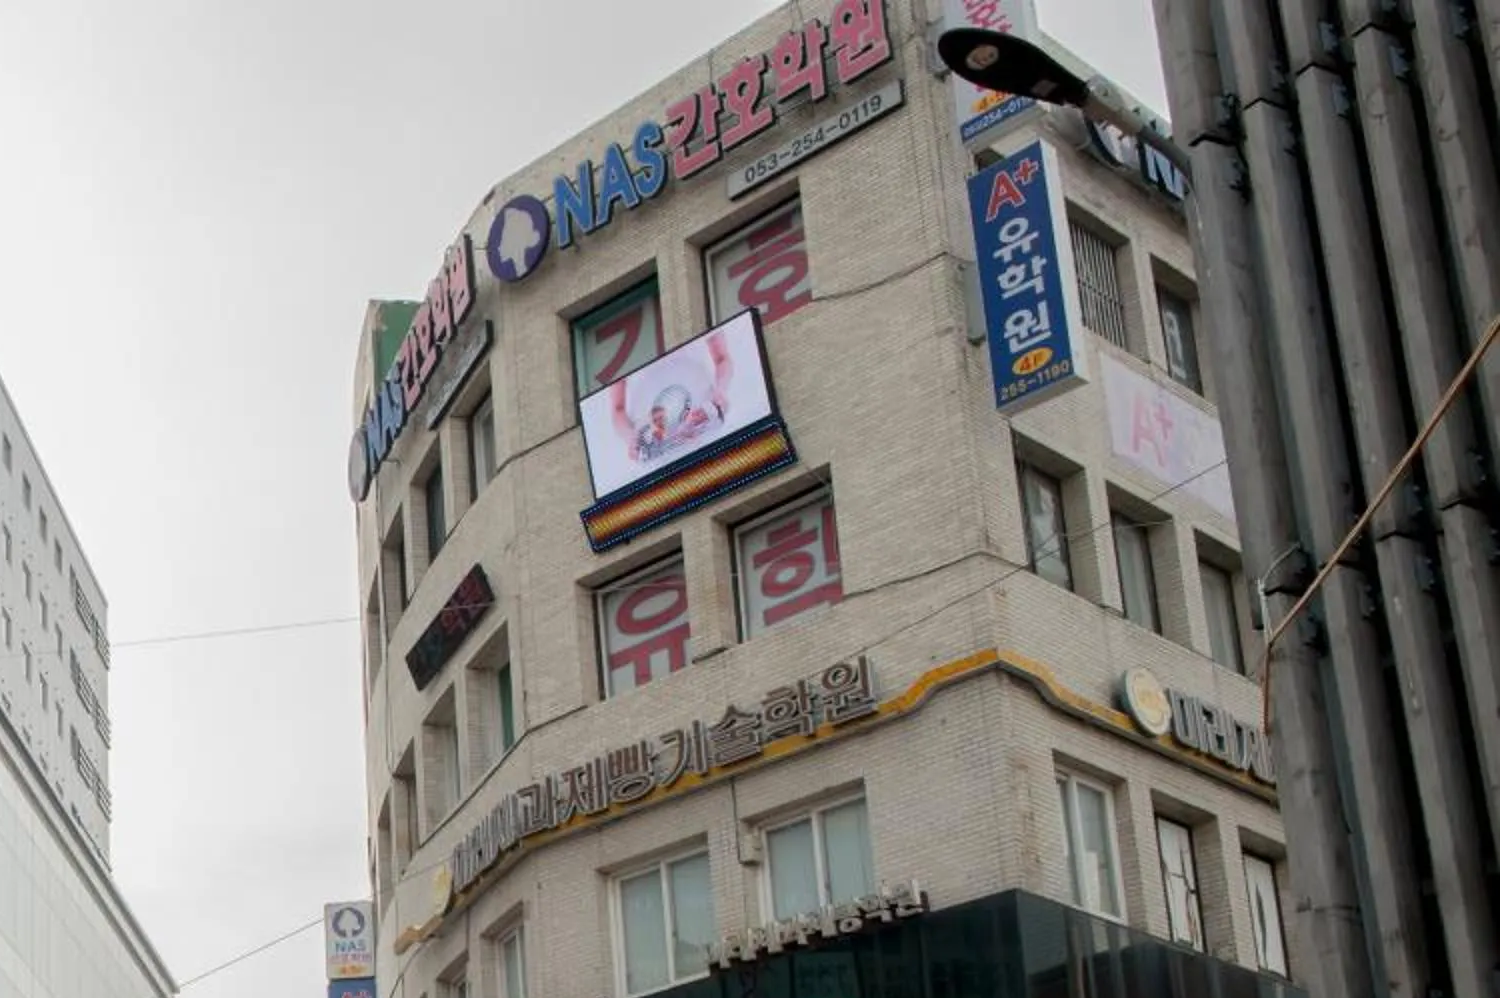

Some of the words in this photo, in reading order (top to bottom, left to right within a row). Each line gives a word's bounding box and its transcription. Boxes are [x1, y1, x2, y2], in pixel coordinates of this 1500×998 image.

[743, 93, 885, 184] 053-254-0119
[986, 157, 1041, 222] A+
[992, 215, 1055, 356] 유학원
[335, 938, 367, 953] NAS
